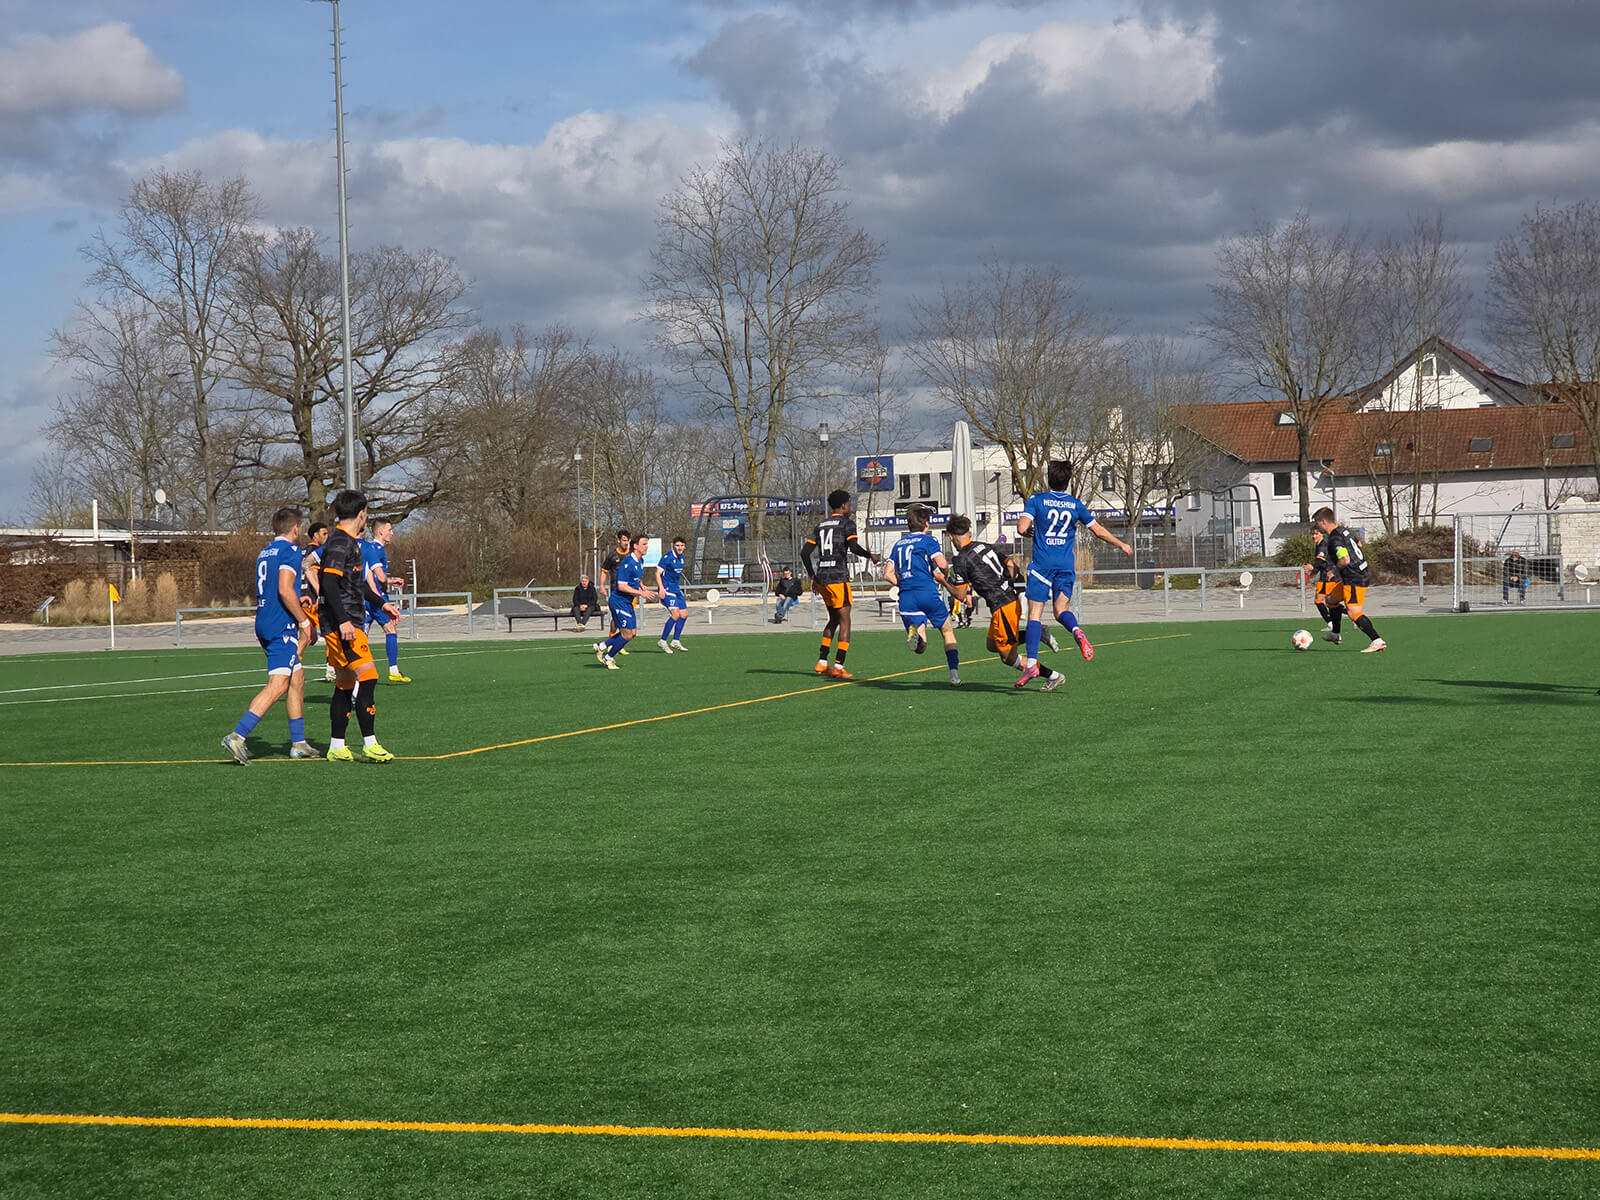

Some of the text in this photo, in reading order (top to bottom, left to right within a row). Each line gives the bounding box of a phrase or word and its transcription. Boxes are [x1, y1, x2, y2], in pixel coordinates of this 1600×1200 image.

[869, 518, 886, 526] TÜV
[1045, 508, 1072, 538] 22
[819, 528, 834, 556] 14
[982, 549, 1004, 579] 17
